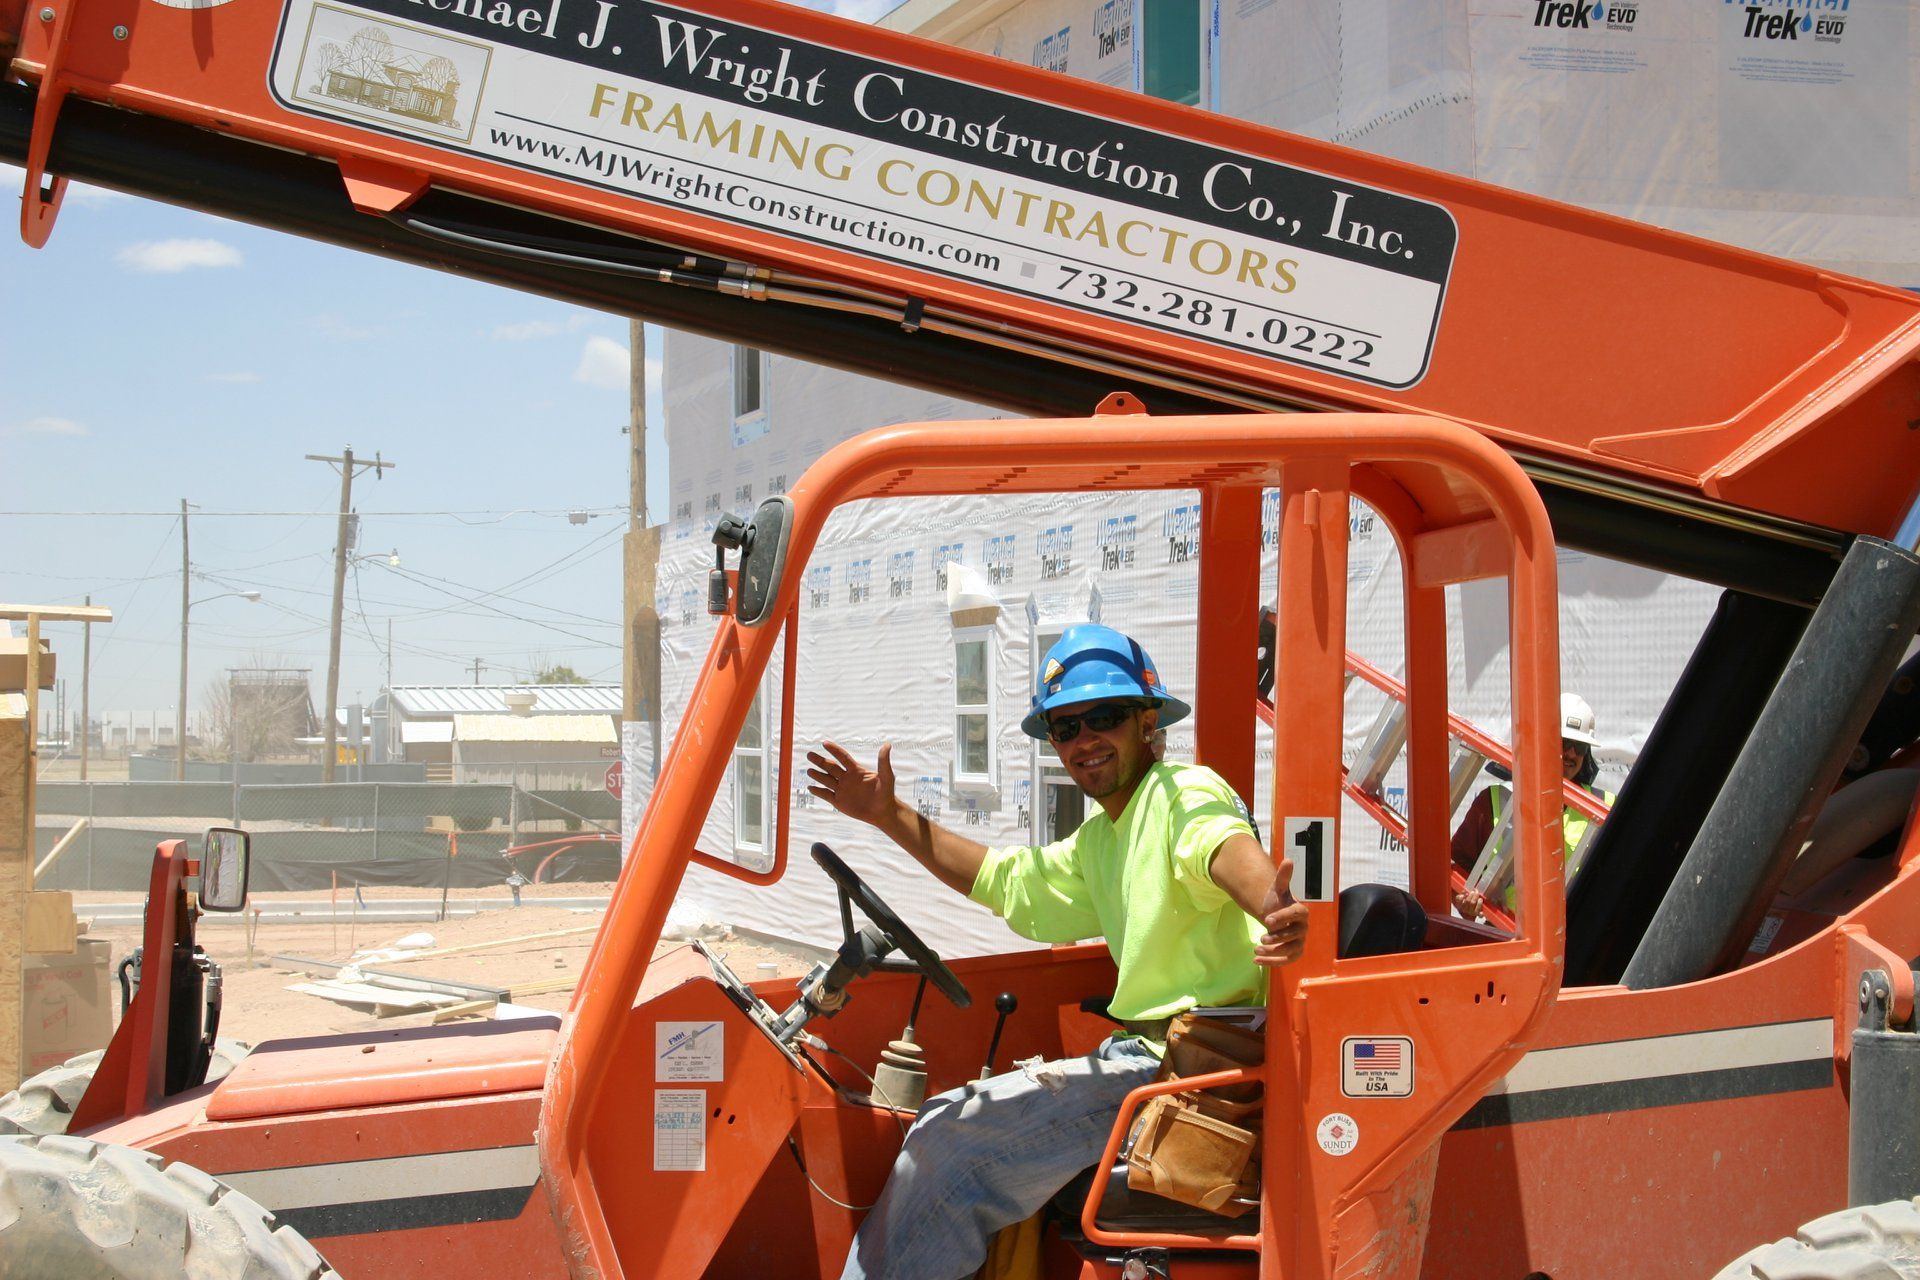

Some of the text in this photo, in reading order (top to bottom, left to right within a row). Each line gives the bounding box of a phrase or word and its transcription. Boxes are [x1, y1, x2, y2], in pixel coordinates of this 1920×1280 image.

[1534, 0, 1593, 29] Trek
[1607, 8, 1637, 23] EVD
[1744, 6, 1801, 40] Trek
[1816, 20, 1844, 35] EVD
[1099, 27, 1117, 60] Trek
[578, 0, 622, 55] J.
[652, 14, 826, 107] Wright
[853, 72, 1180, 199] Construction
[1203, 162, 1302, 237] Co.,
[1322, 190, 1414, 259] Inc.
[589, 82, 1299, 294] FRAMING CONTRACTORS
[490, 128, 1375, 368] www.MJWrightConstruction.com 732.281.0222
[1097, 515, 1136, 546] Weather
[1102, 544, 1120, 571] Trek
[1169, 535, 1190, 563] Trek
[987, 562, 1002, 586] Trek
[1041, 553, 1058, 579] Trek
[936, 569, 947, 591] Tre
[607, 772, 622, 788] ST
[1018, 805, 1031, 829] Tre
[1295, 821, 1323, 900] 1
[1366, 1082, 1388, 1091] USA
[1323, 1140, 1352, 1149] SUNDT
